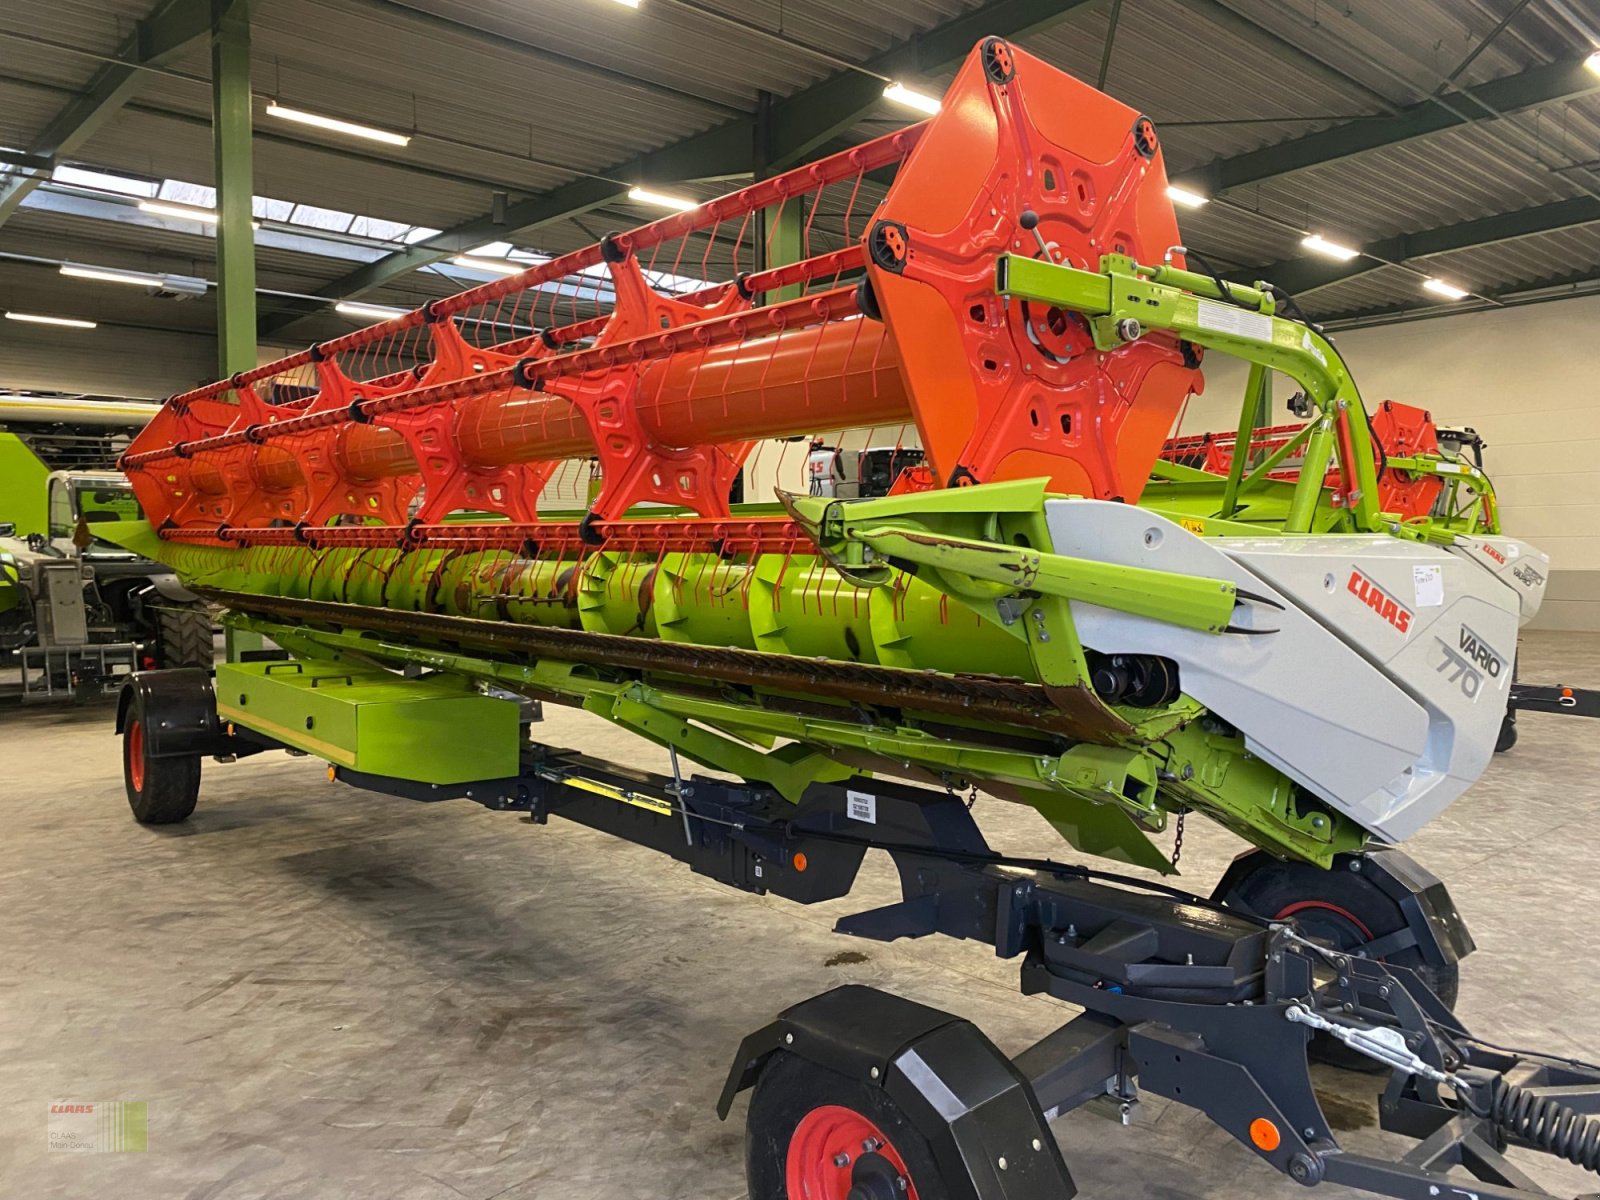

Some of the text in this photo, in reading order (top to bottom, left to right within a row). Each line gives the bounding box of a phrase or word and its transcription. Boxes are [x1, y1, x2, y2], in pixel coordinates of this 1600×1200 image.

[1482, 543, 1505, 565] CLAAS
[1346, 571, 1411, 634] CLAAS
[1436, 646, 1480, 699] 770
[1459, 627, 1501, 678] VARIO
